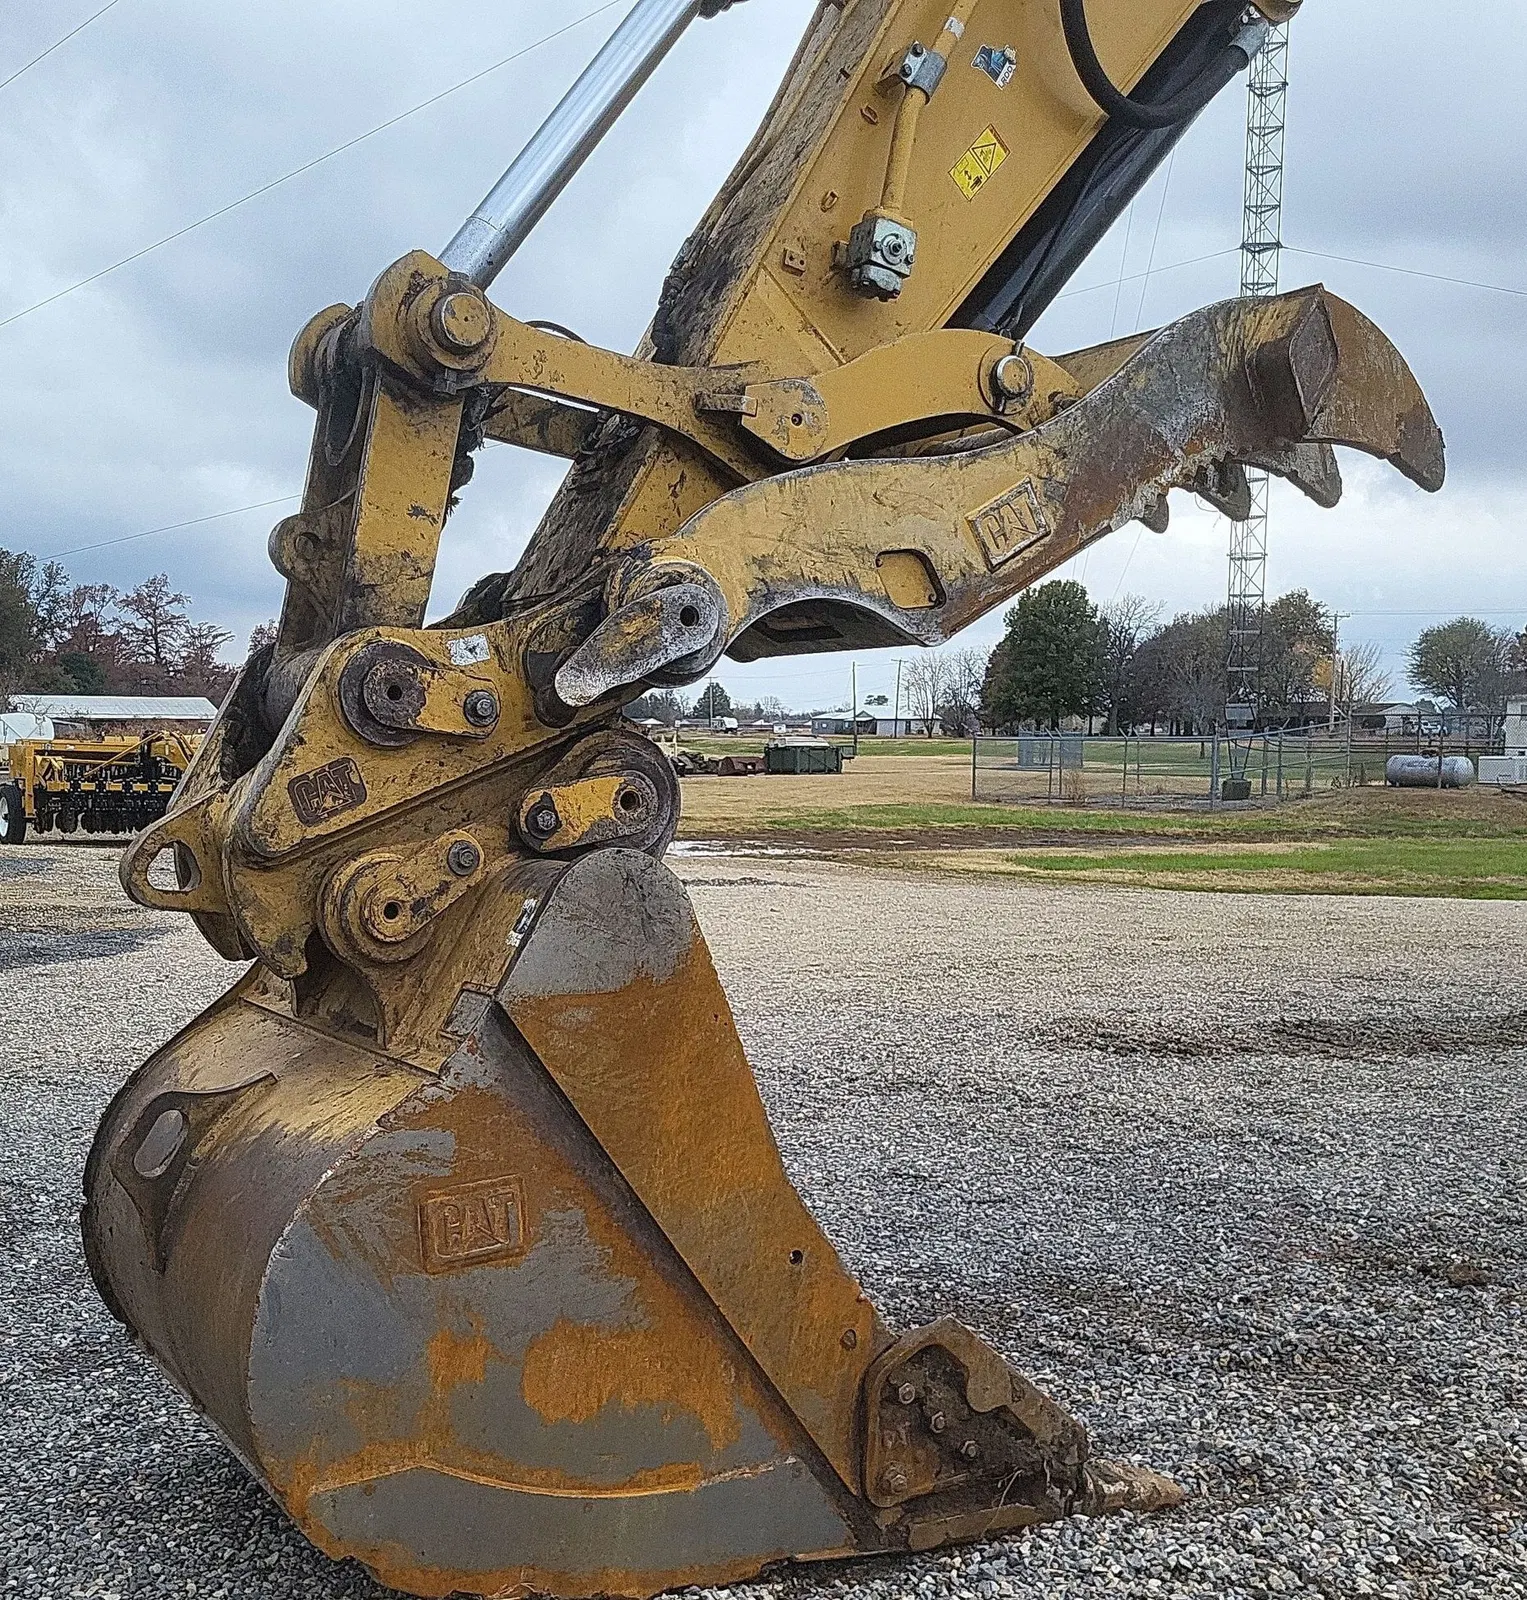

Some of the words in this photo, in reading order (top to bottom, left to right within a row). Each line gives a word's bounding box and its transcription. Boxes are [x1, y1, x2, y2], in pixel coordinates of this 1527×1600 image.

[980, 490, 1040, 557] CAT
[295, 762, 358, 819] CAT
[434, 1188, 514, 1258] CAT
